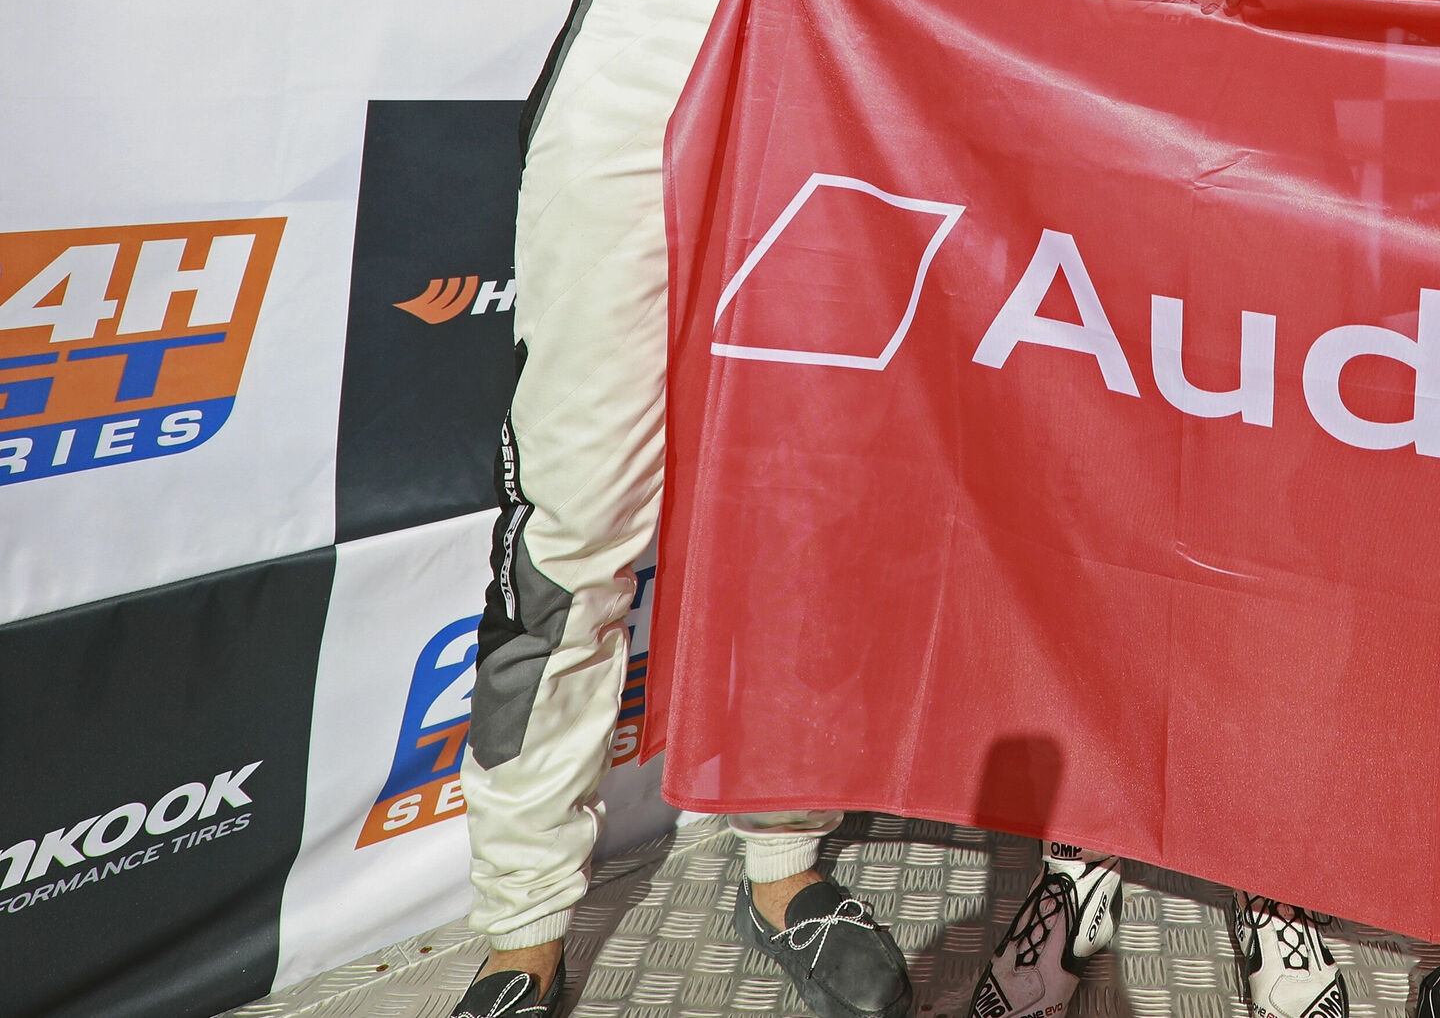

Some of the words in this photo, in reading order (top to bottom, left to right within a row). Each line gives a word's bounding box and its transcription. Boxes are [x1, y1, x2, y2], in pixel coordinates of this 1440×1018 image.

[0, 234, 257, 344] 4H
[0, 409, 203, 475] RIES
[0, 842, 164, 914] FORMANCE
[170, 812, 253, 854] TIRES
[1088, 894, 1109, 943] OMP
